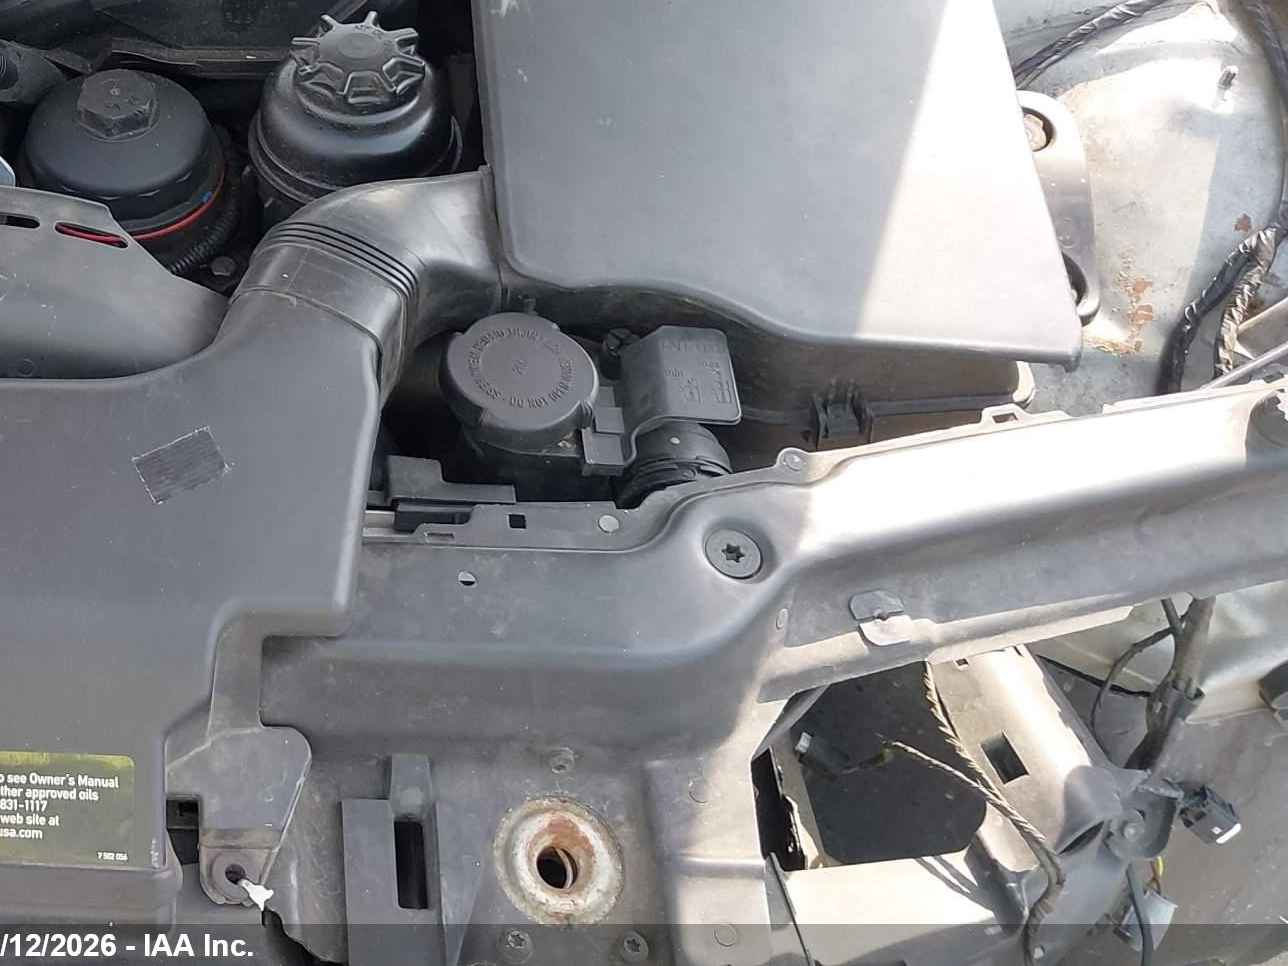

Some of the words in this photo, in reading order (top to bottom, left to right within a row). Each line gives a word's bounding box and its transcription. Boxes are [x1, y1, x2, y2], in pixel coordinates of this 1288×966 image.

[7, 774, 27, 784] see
[29, 772, 75, 786] Owner's
[77, 774, 120, 789] Manual
[25, 786, 77, 802] approved
[78, 790, 100, 801] oils
[0, 812, 24, 825] web
[26, 814, 47, 826] site
[48, 815, 60, 826] at
